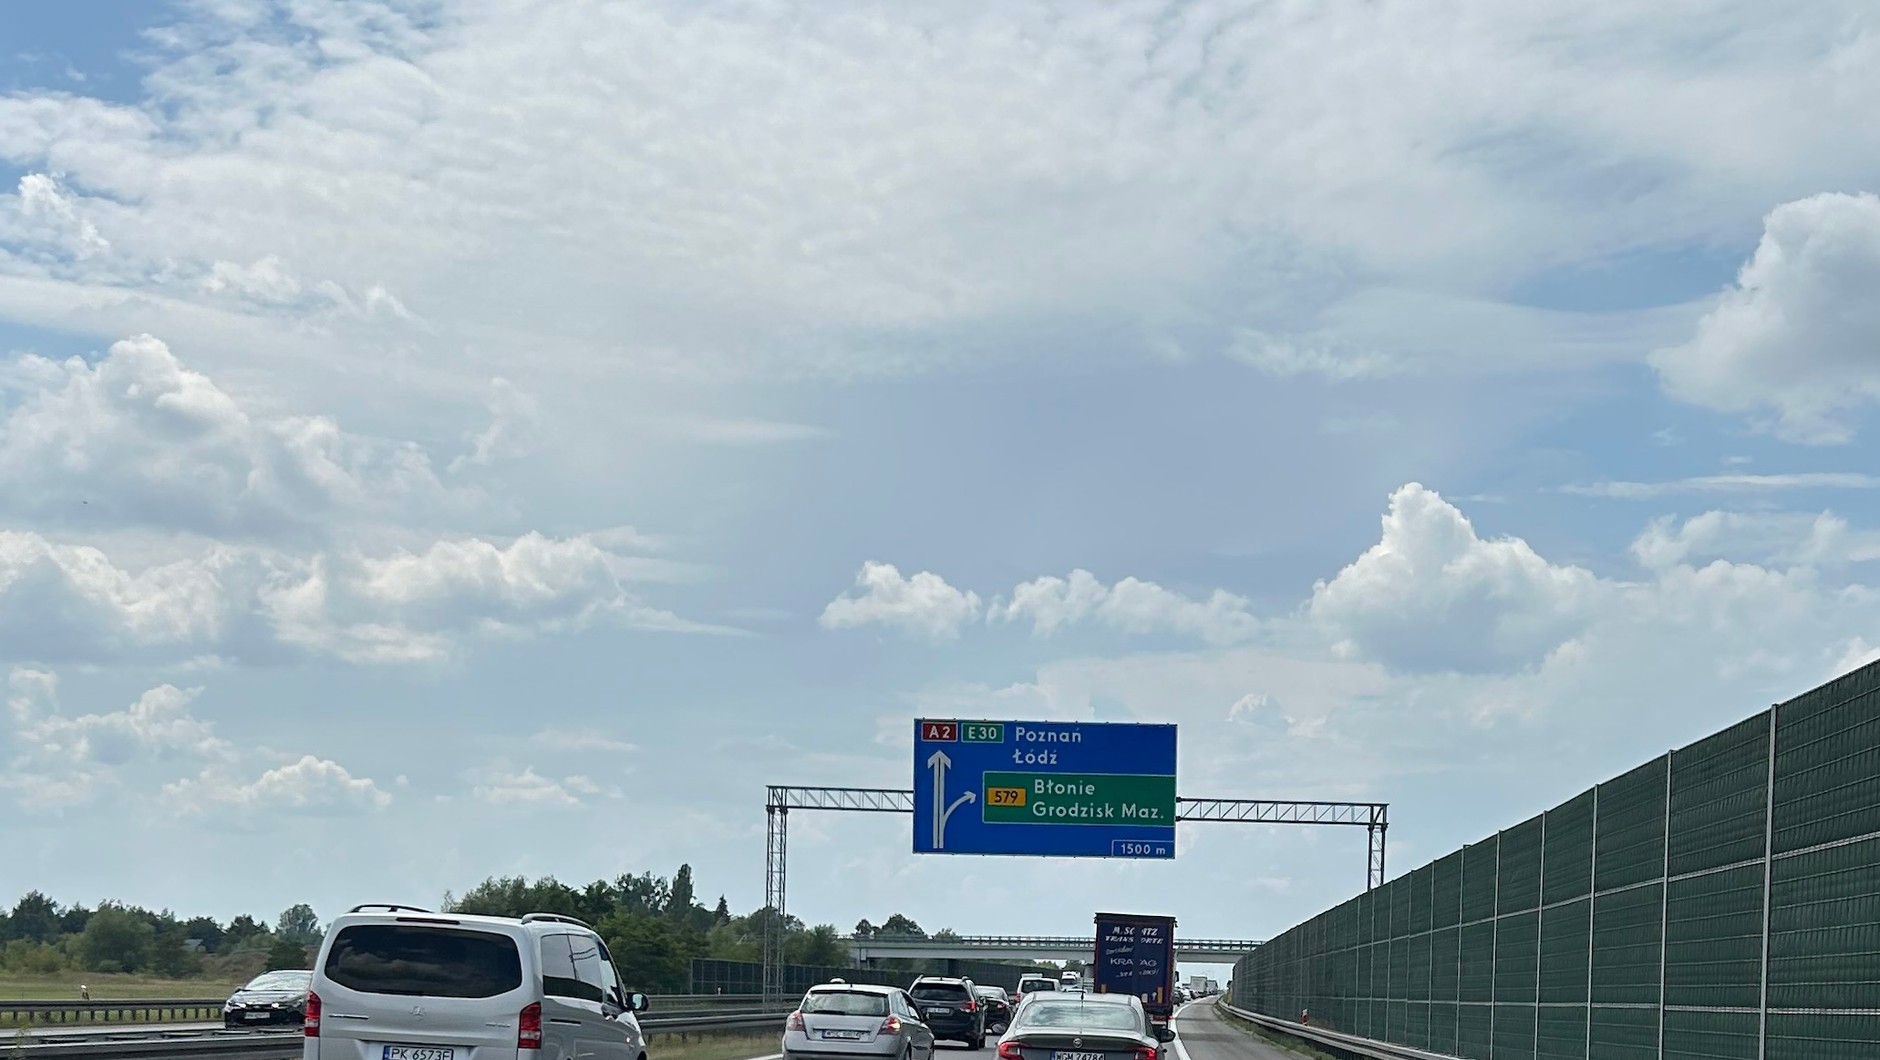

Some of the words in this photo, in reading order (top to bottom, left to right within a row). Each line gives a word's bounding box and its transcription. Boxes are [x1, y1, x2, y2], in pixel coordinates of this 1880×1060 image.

[928, 725, 951, 739] A2
[968, 726, 998, 740] E30
[1015, 726, 1082, 743] Poznań
[1012, 747, 1058, 765] Łódź
[1034, 779, 1096, 796] Błonie
[993, 790, 1019, 804] 579
[1032, 801, 1115, 819] Grodzisk
[1121, 803, 1165, 820] Maz.
[1120, 843, 1151, 855] 1500
[1156, 847, 1166, 856] m
[1110, 957, 1158, 967] KRAAG
[392, 1048, 409, 1060] PK
